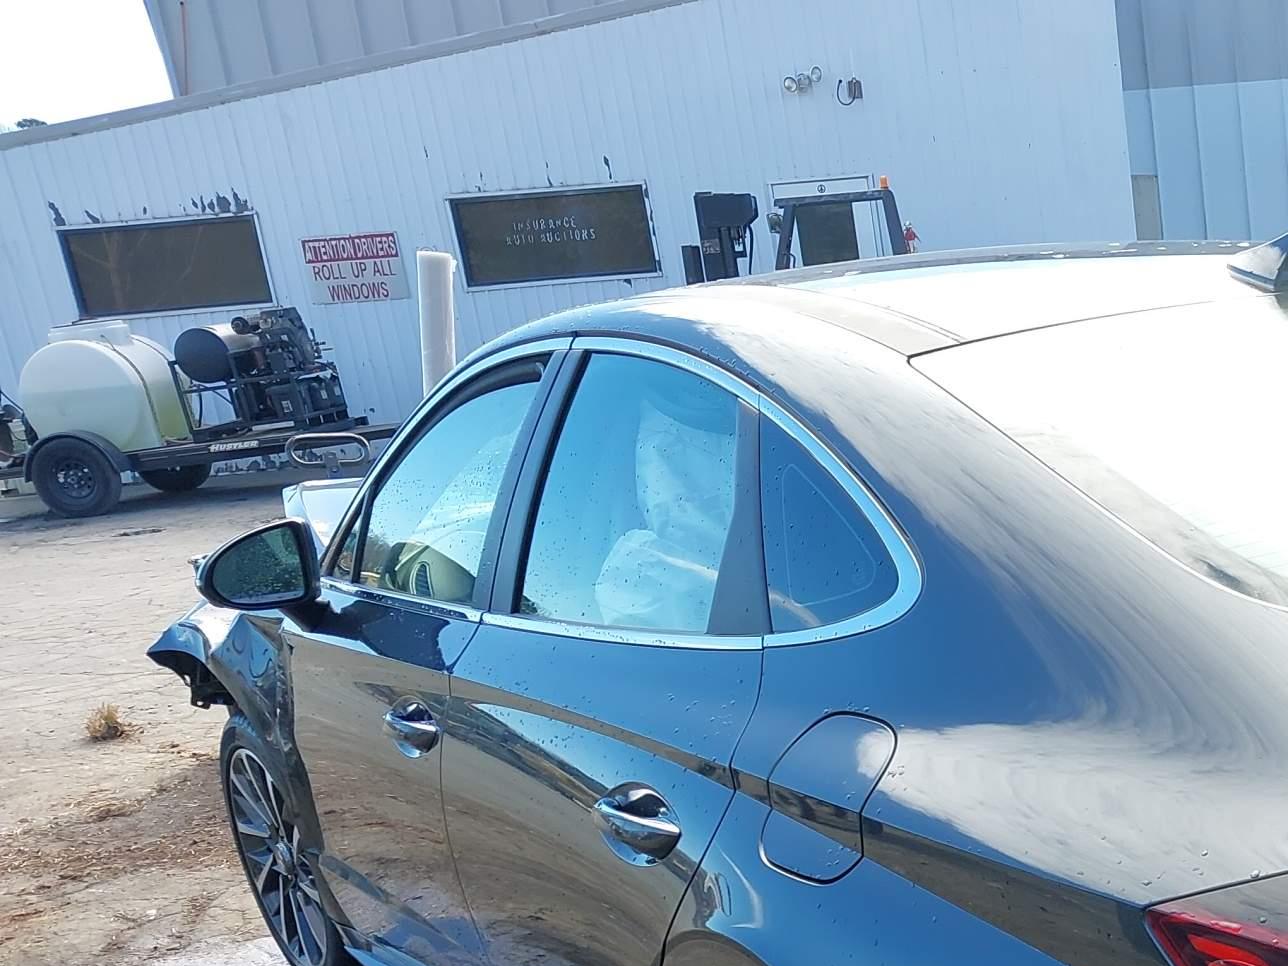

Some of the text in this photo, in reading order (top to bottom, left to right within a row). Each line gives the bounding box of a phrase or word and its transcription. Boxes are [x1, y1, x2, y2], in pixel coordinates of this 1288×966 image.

[304, 236, 397, 262] ATTENTION DRIVERS
[313, 259, 397, 281] ROLL UP ALL
[328, 282, 390, 302] WINDOWS
